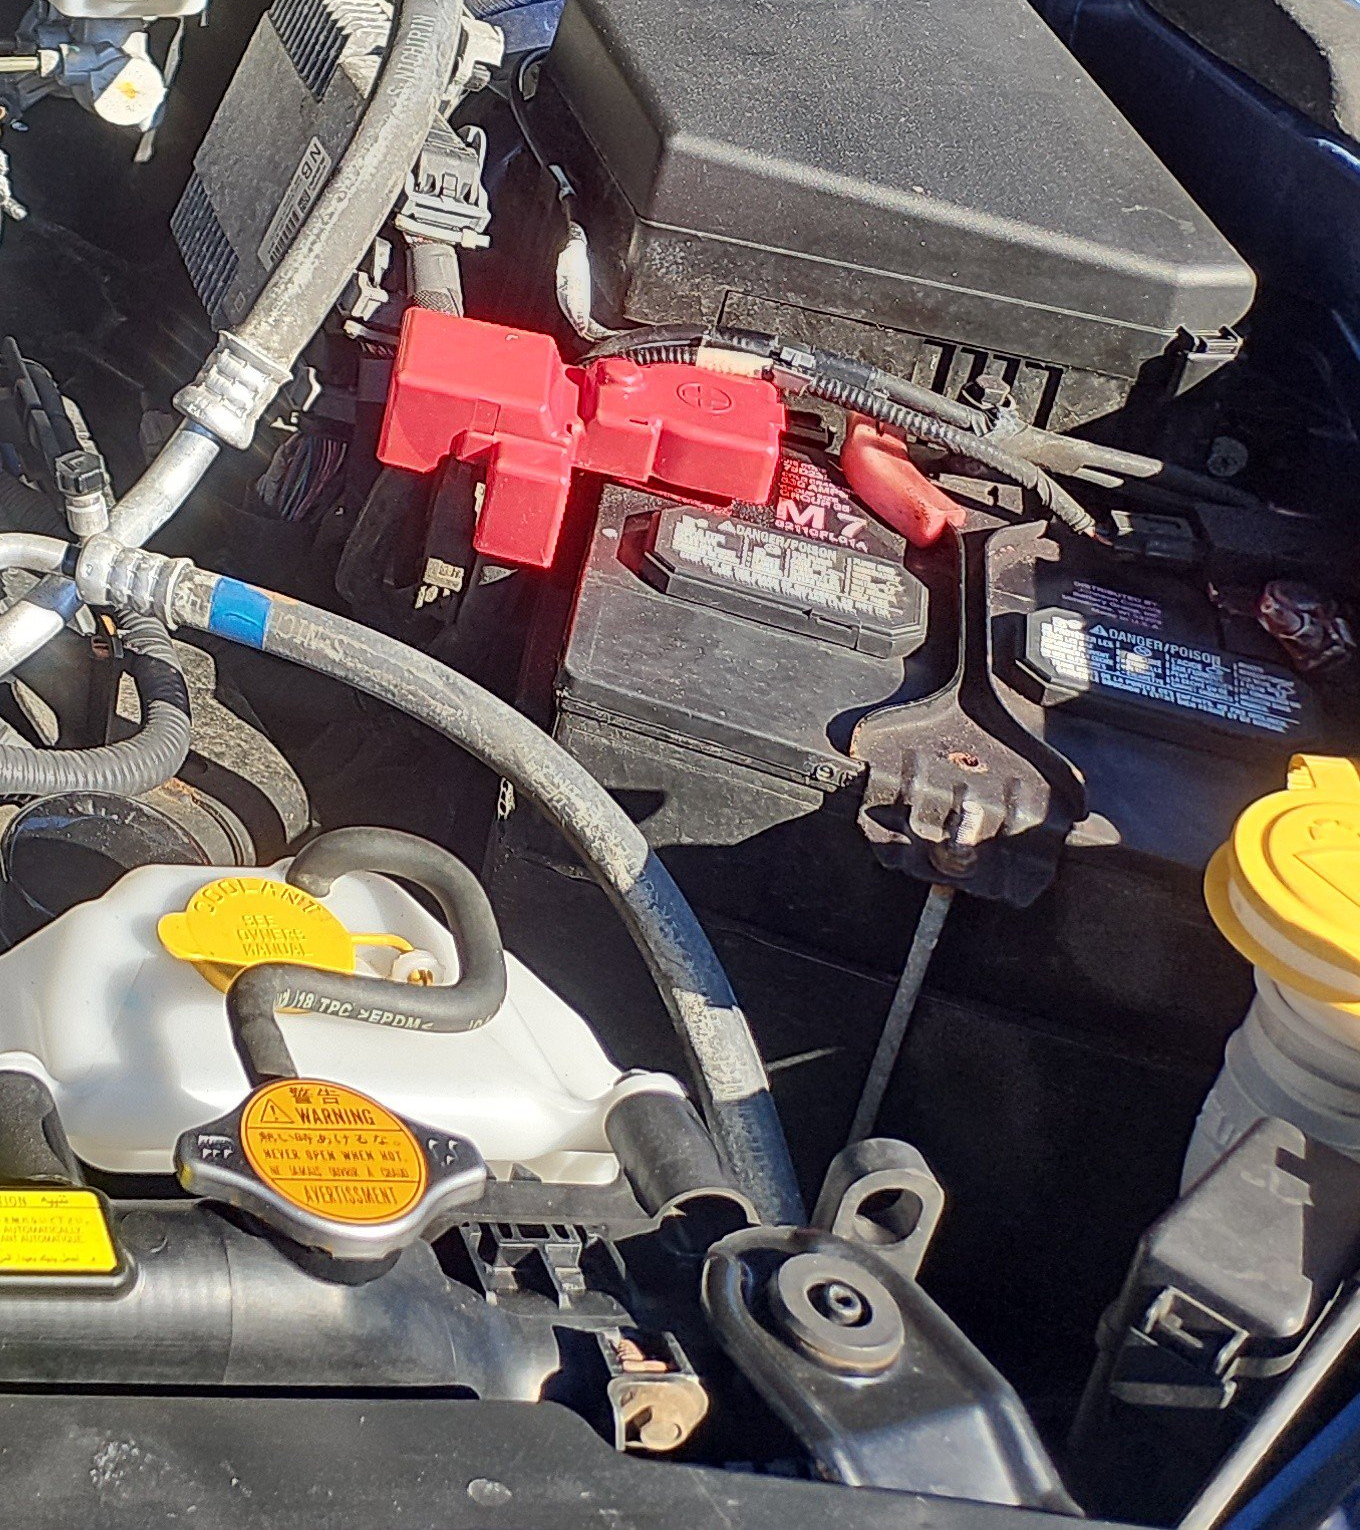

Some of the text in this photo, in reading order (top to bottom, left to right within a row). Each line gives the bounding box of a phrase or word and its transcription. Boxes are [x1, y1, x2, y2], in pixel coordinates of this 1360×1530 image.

[777, 498, 827, 529] M
[837, 513, 865, 538] 7
[194, 878, 322, 915] COOLANT
[242, 915, 274, 927] SEE
[241, 943, 314, 957] MANUAL
[320, 997, 354, 1019] TPC
[289, 1087, 340, 1105] 警告
[294, 1107, 376, 1126] WARNING
[263, 1148, 300, 1160] NEVER
[306, 1149, 335, 1161] OPEN
[343, 1150, 374, 1161] WHEN
